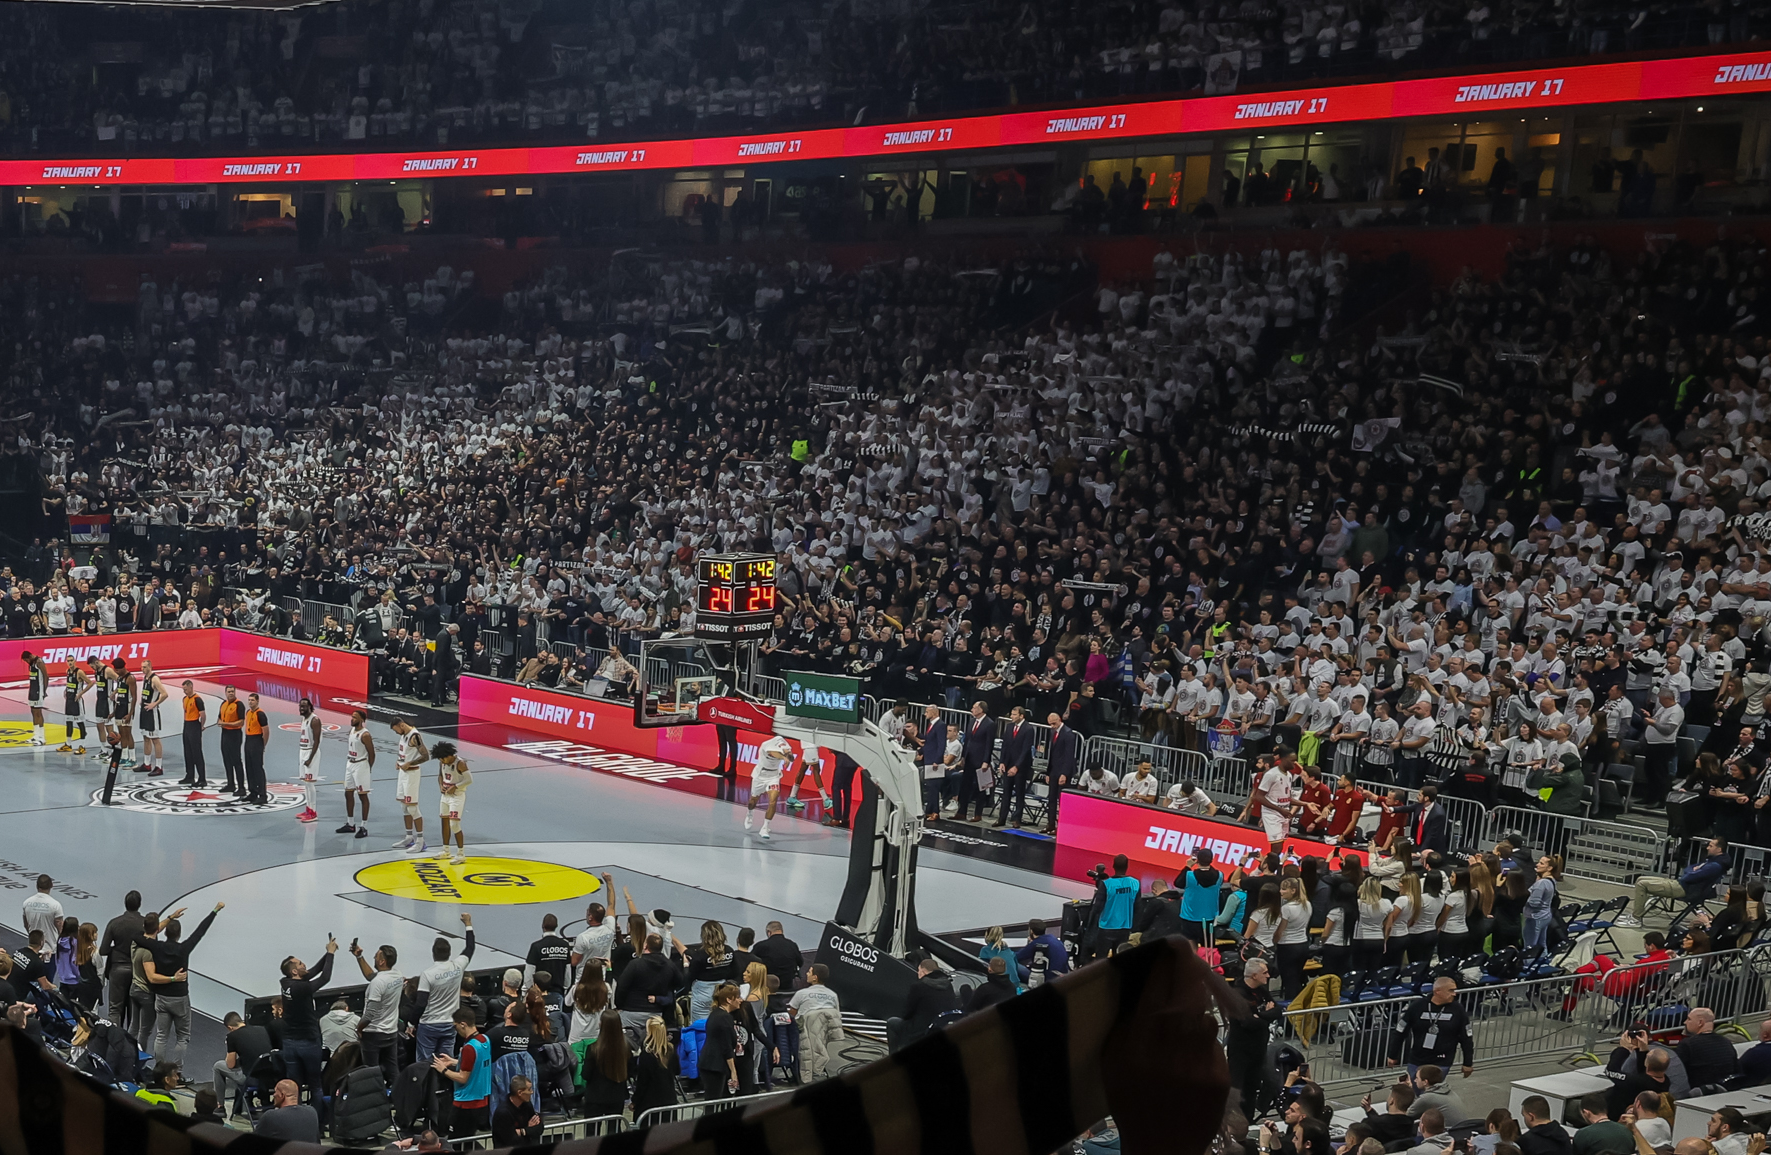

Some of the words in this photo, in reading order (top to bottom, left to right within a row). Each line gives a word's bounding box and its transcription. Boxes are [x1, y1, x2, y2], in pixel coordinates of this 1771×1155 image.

[1456, 82, 1536, 101] JANUARY
[1541, 80, 1563, 95] 17
[1235, 100, 1304, 118] JANUARY
[1309, 99, 1327, 112] 17
[1047, 116, 1105, 132] JANUARY
[1110, 115, 1125, 128] 17
[884, 130, 934, 145] JANUARY
[938, 129, 952, 141] 17
[739, 142, 785, 155] JANUARY
[789, 141, 801, 152] 17
[403, 159, 458, 170] JANUARY
[462, 158, 477, 168] 17
[577, 152, 627, 164] JANUARY
[631, 151, 644, 161] 17
[43, 167, 101, 177] JANUARY
[106, 167, 121, 176] 17
[224, 164, 281, 175] JANUARY
[286, 164, 300, 173] 17
[710, 563, 732, 580] 1:42
[748, 560, 775, 578] 1:42
[711, 587, 732, 611] 24
[749, 587, 775, 611] 24
[705, 623, 729, 633] TISSOT
[745, 622, 772, 632] TISSOT
[42, 644, 123, 664] JANUARY
[129, 643, 149, 659] 17
[256, 646, 305, 669] JANUARY
[308, 656, 321, 673] 17
[508, 697, 573, 725] JANUARY
[576, 710, 596, 730] 17
[502, 740, 724, 783] BELGRADE
[1220, 802, 1236, 815] mts
[409, 862, 462, 899] MOZZART
[541, 947, 568, 955] GLOBOS
[830, 935, 880, 964] GLOBOS
[840, 955, 875, 973] OSIGURANJE
